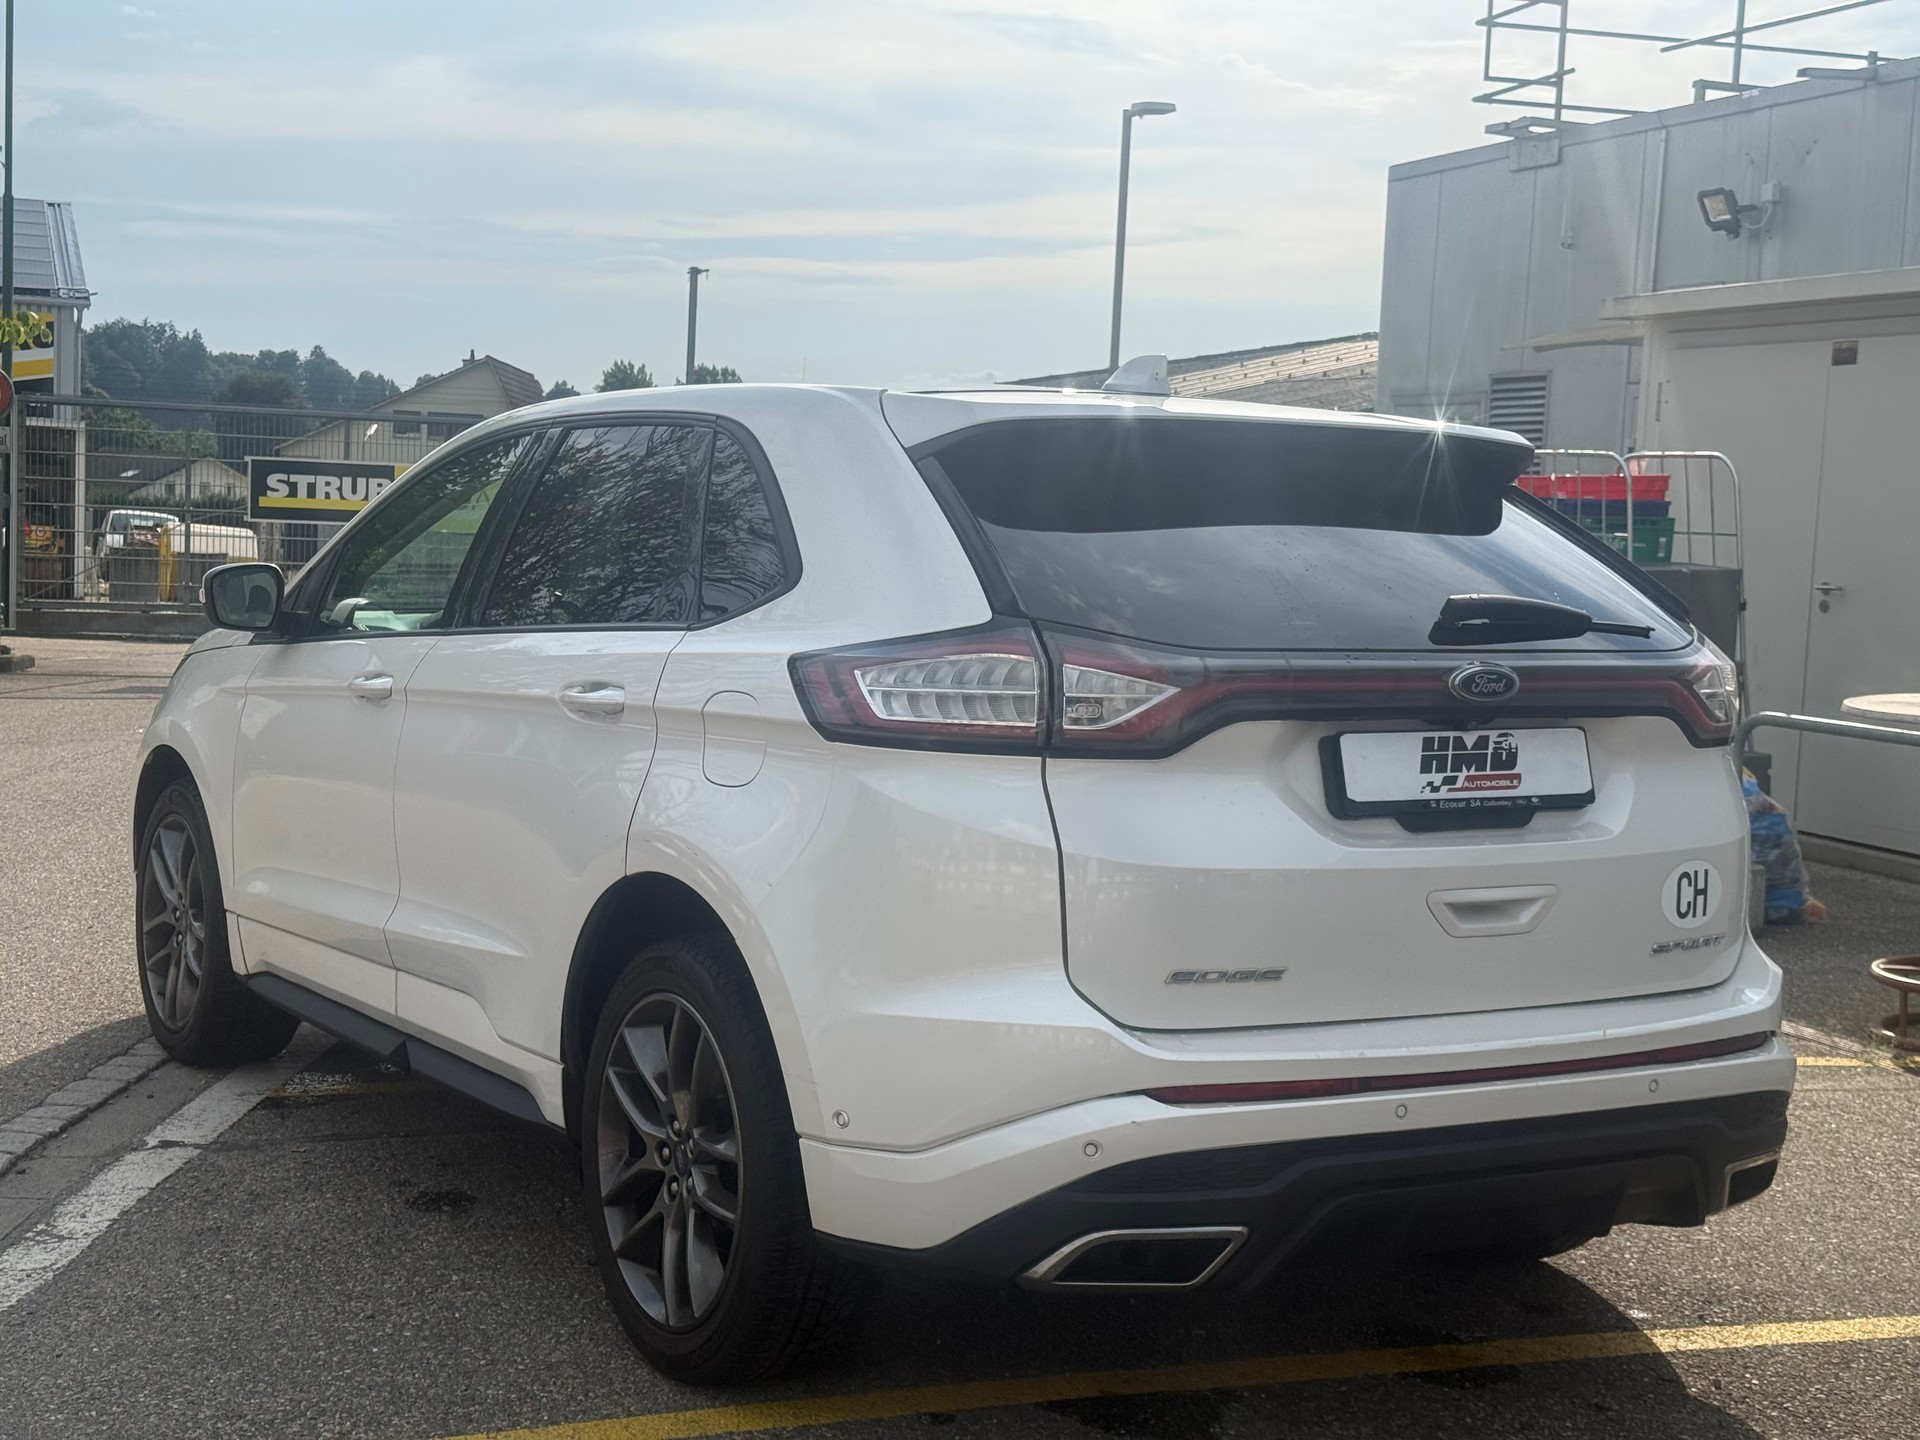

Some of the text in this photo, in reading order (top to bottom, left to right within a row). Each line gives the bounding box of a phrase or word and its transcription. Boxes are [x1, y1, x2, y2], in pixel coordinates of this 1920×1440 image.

[1471, 673, 1506, 693] Ford
[1463, 779, 1519, 788] AUTOMOBILE
[1676, 868, 1708, 919] CH
[1164, 966, 1288, 985] EDGE
